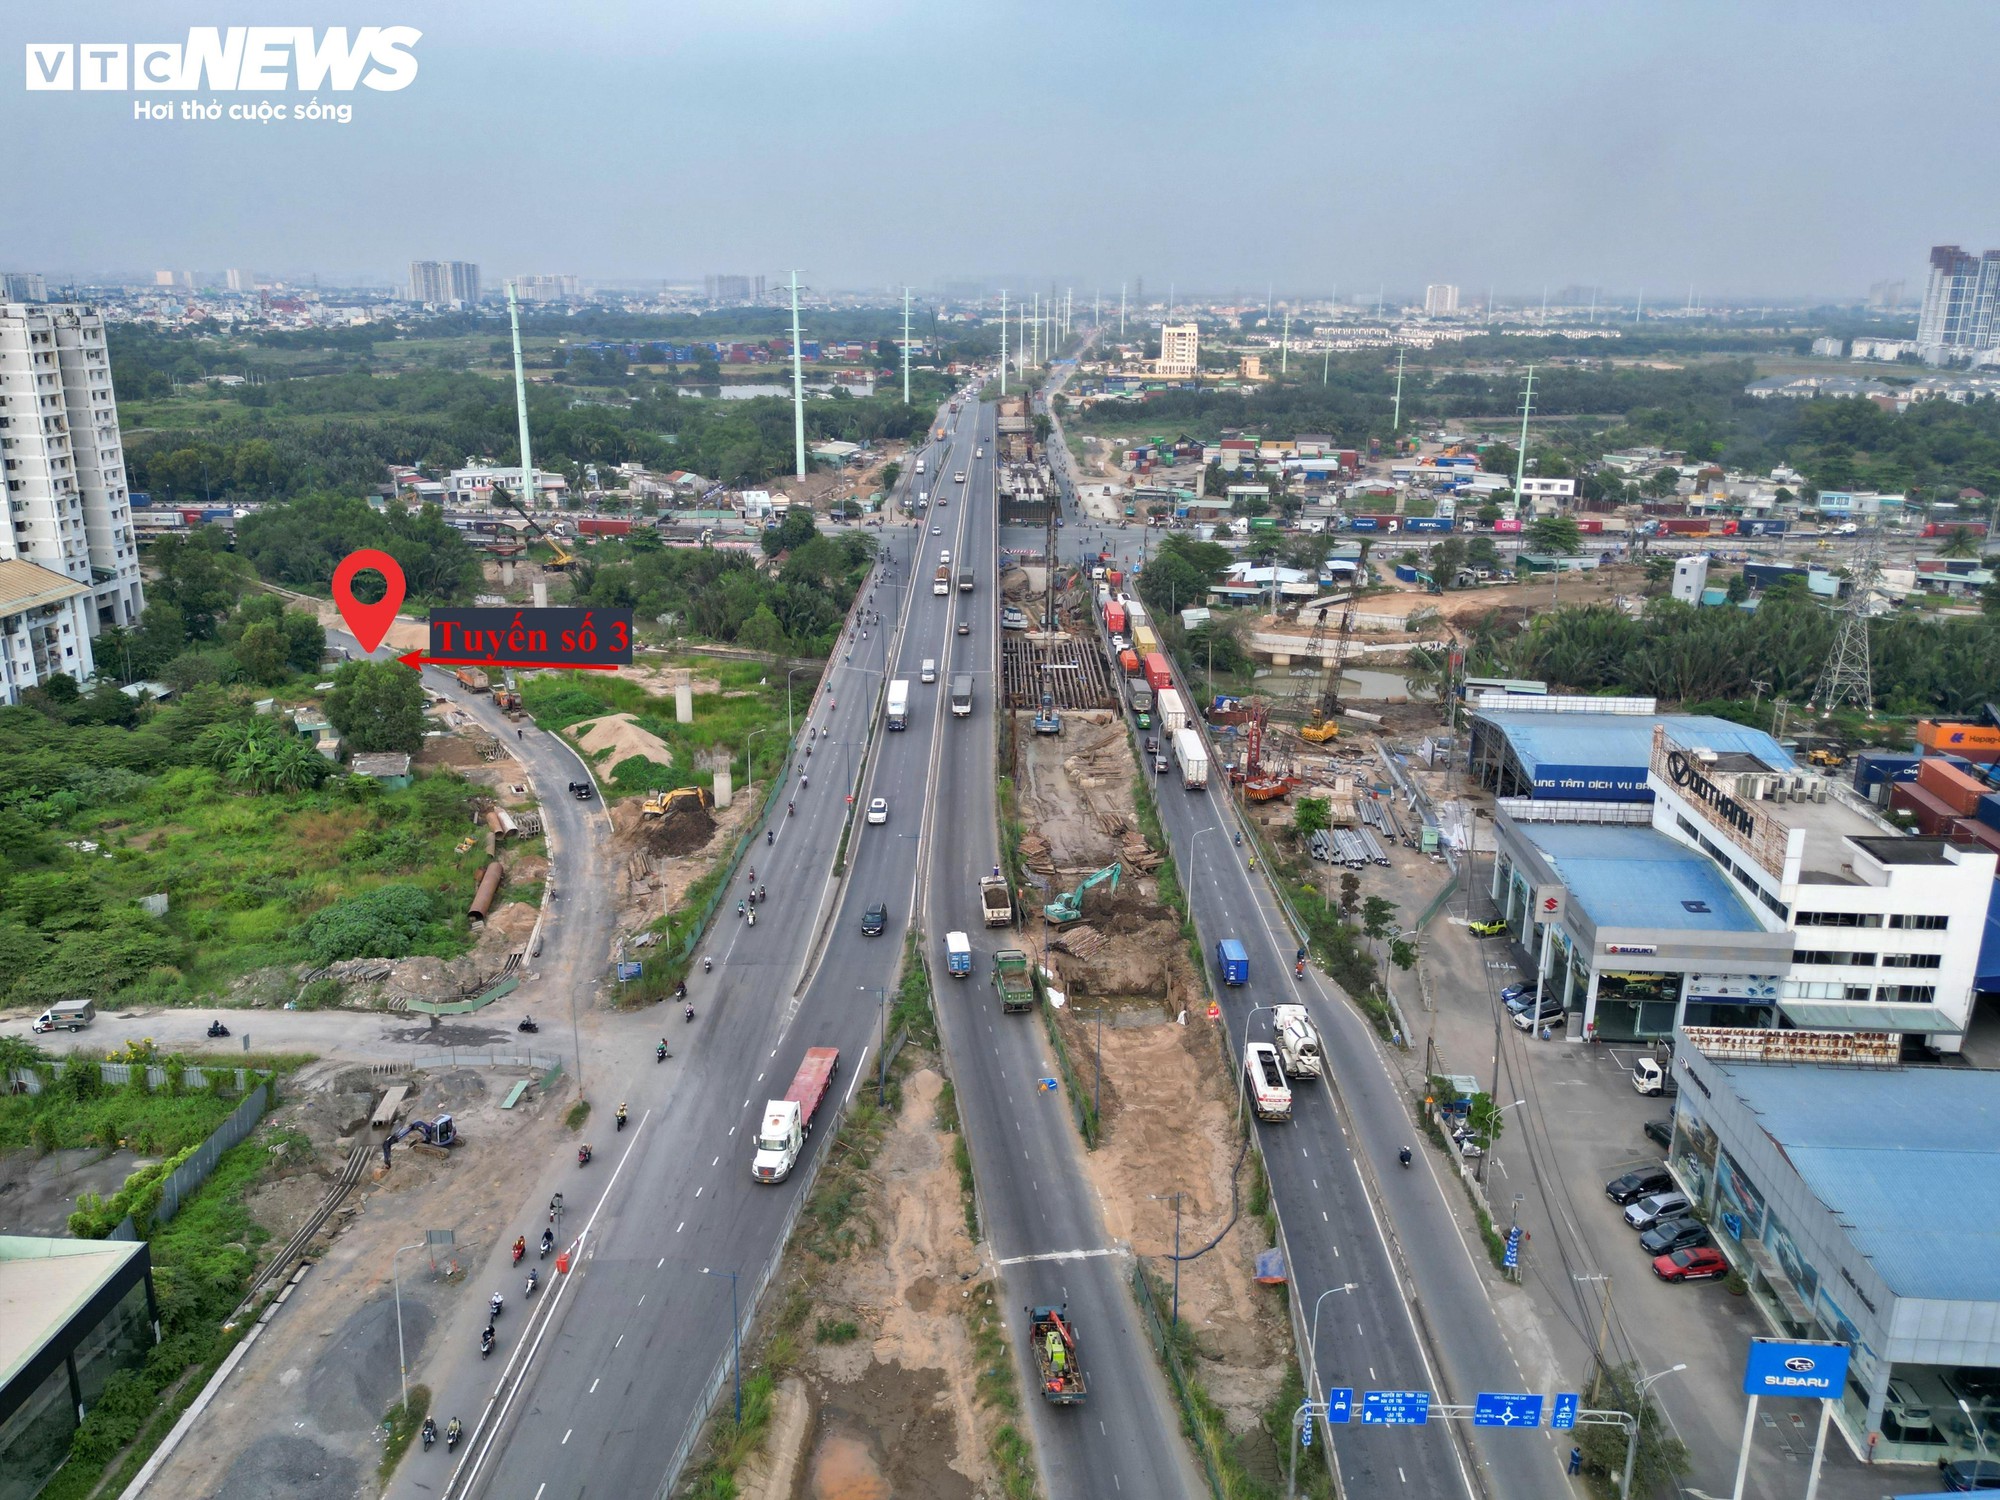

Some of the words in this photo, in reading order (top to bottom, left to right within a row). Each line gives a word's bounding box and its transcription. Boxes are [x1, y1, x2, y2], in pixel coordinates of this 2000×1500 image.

[1560, 778, 1584, 788] TÂM
[1588, 780, 1612, 790] DỊCH
[1617, 782, 1632, 791] VỤ
[1765, 1375, 1829, 1388] SUBARU
